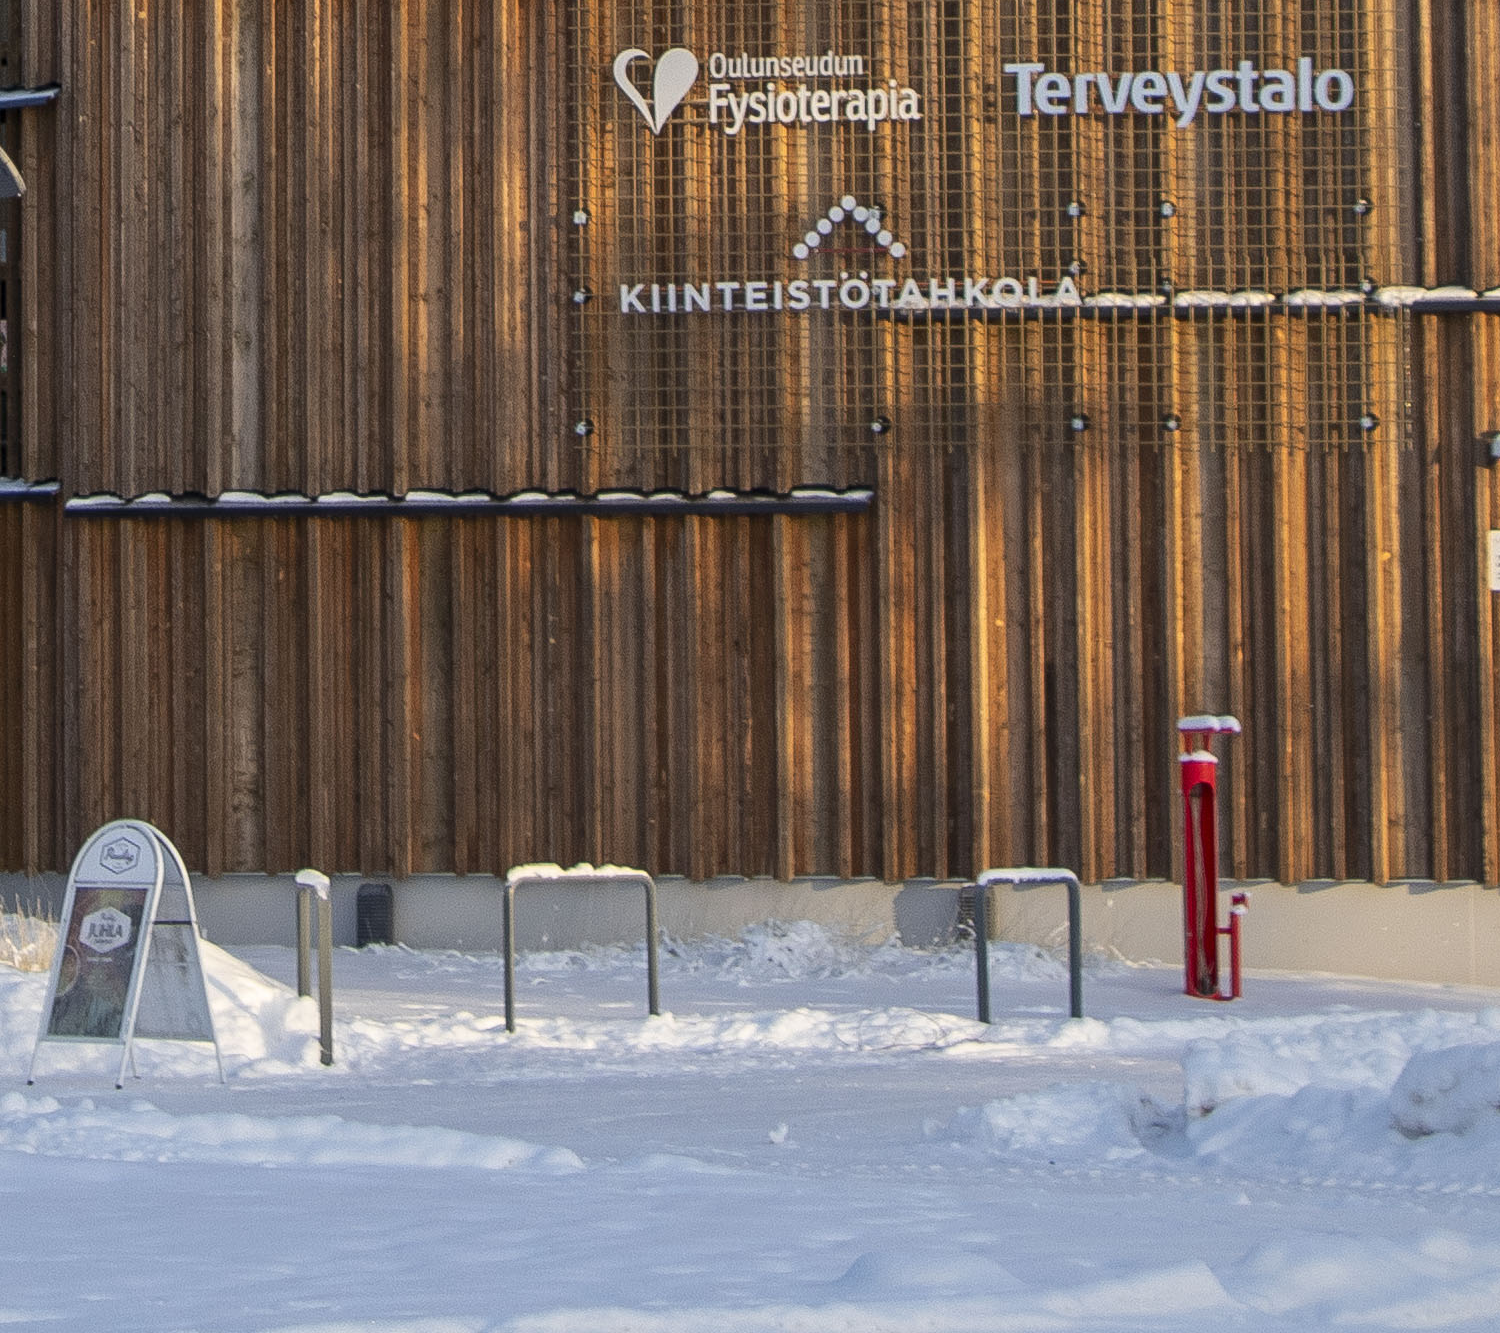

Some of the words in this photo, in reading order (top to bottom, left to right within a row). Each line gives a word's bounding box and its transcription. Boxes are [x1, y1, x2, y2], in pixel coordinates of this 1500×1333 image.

[709, 50, 864, 79] Oulunseudun
[1003, 56, 1354, 129] Terveystalo
[709, 78, 922, 135] Fysioterapia
